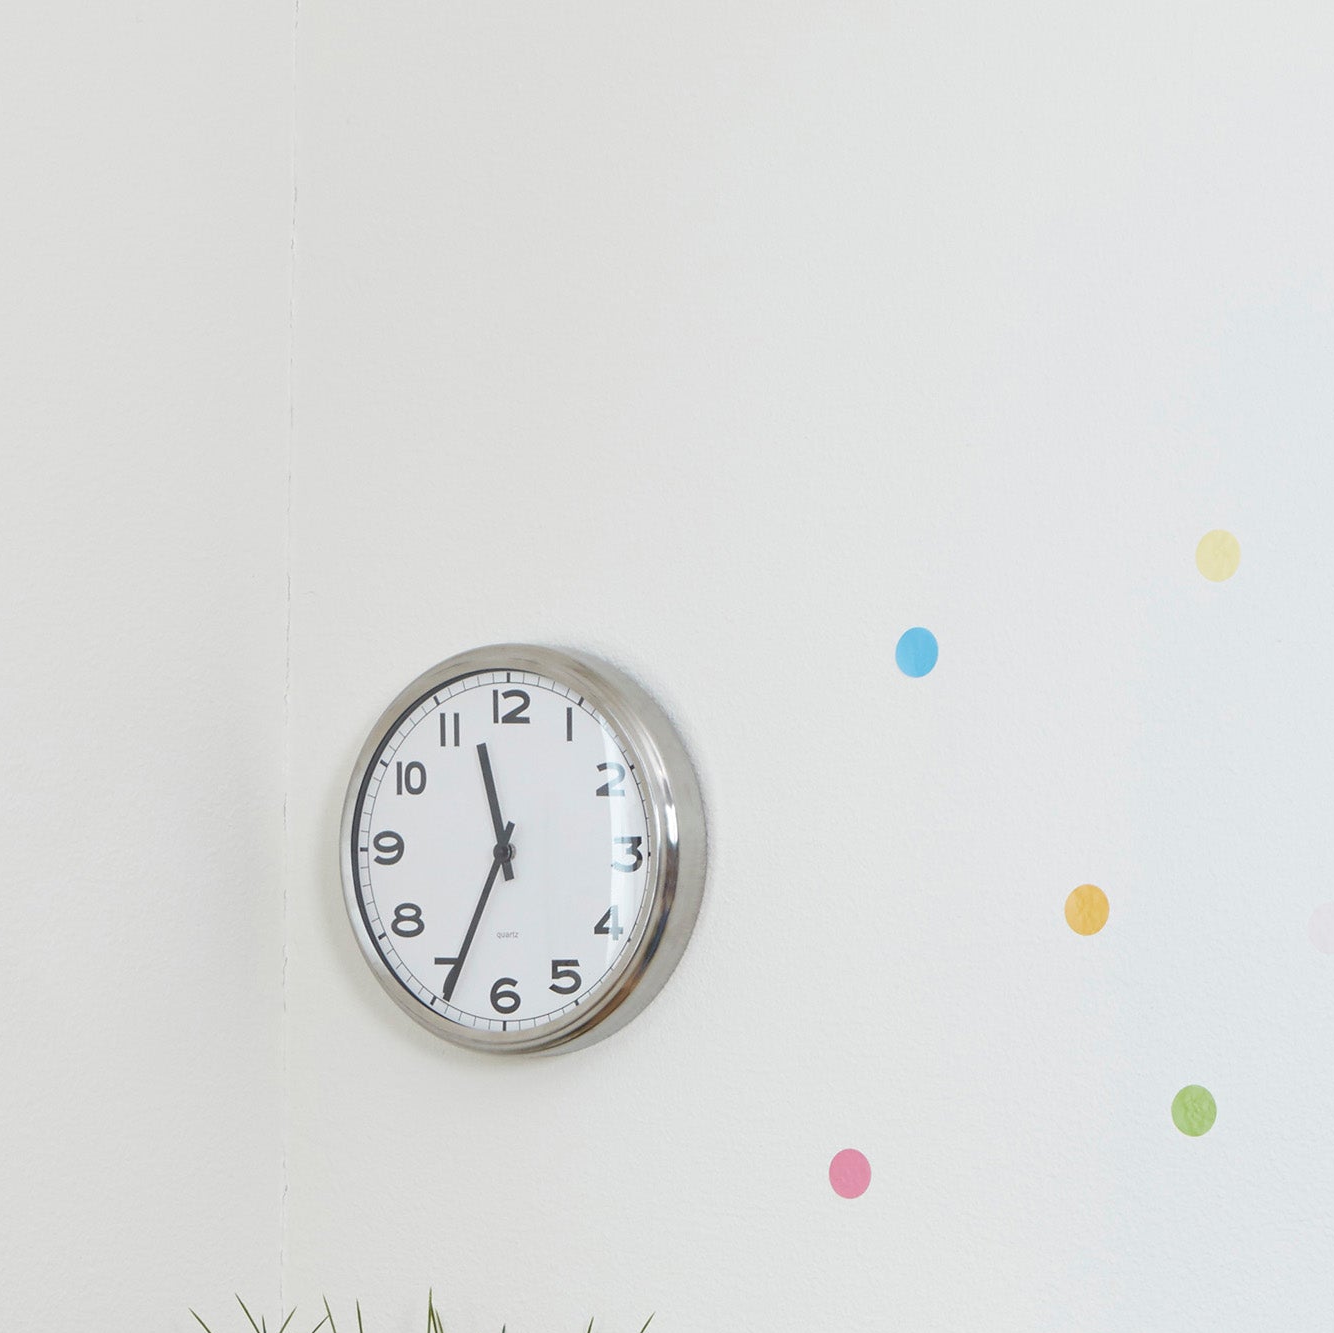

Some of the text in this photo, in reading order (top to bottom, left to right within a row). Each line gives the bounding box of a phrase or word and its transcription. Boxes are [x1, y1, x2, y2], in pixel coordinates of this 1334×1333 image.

[492, 689, 531, 724] 12
[566, 707, 573, 742] 1
[440, 712, 460, 747] 11
[396, 761, 427, 795] 10
[596, 762, 626, 797] 2
[373, 830, 405, 866] 9
[611, 836, 643, 873] 3
[391, 902, 425, 938] 8
[496, 930, 519, 939] quartz
[593, 904, 624, 941] 4
[434, 957, 463, 995] 7
[549, 959, 583, 996] 5
[490, 976, 521, 1015] 6
